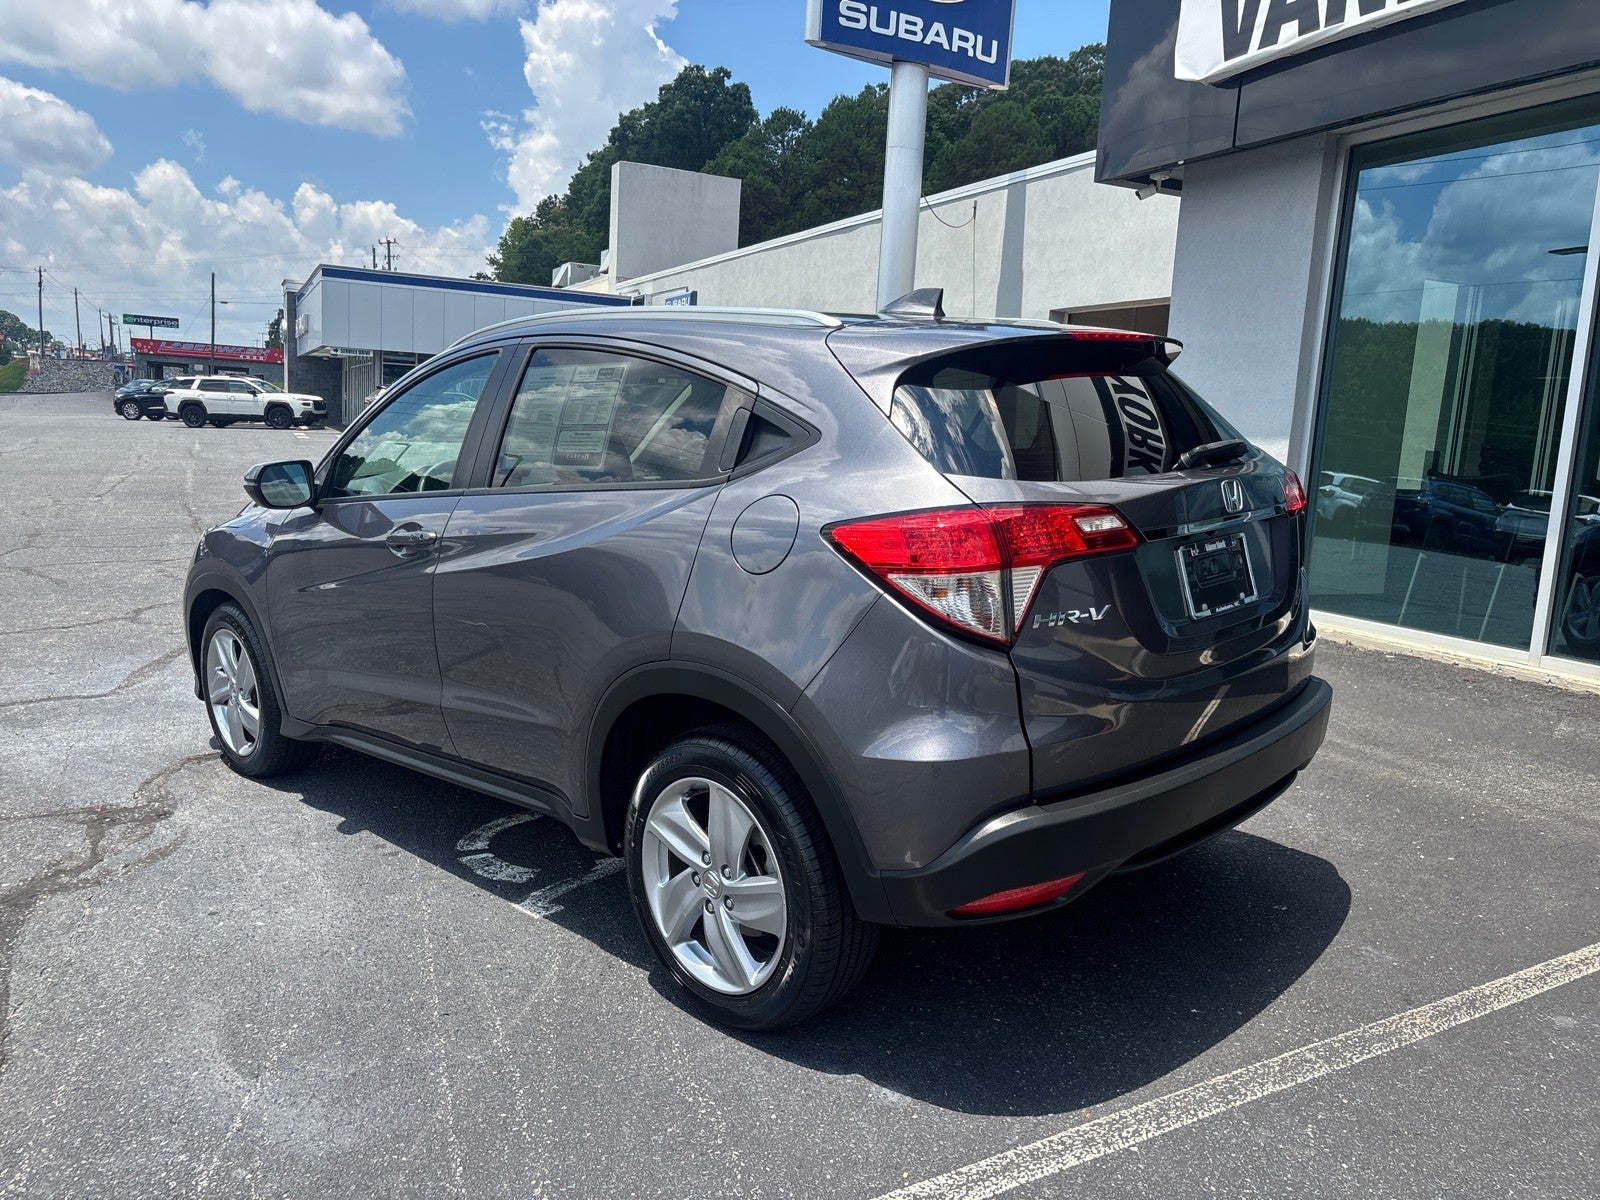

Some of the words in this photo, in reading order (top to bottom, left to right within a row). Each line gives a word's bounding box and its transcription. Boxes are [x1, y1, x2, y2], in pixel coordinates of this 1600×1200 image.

[838, 0, 998, 64] SUBARU
[124, 315, 178, 326] enterprise
[1032, 604, 1112, 629] HR-V
